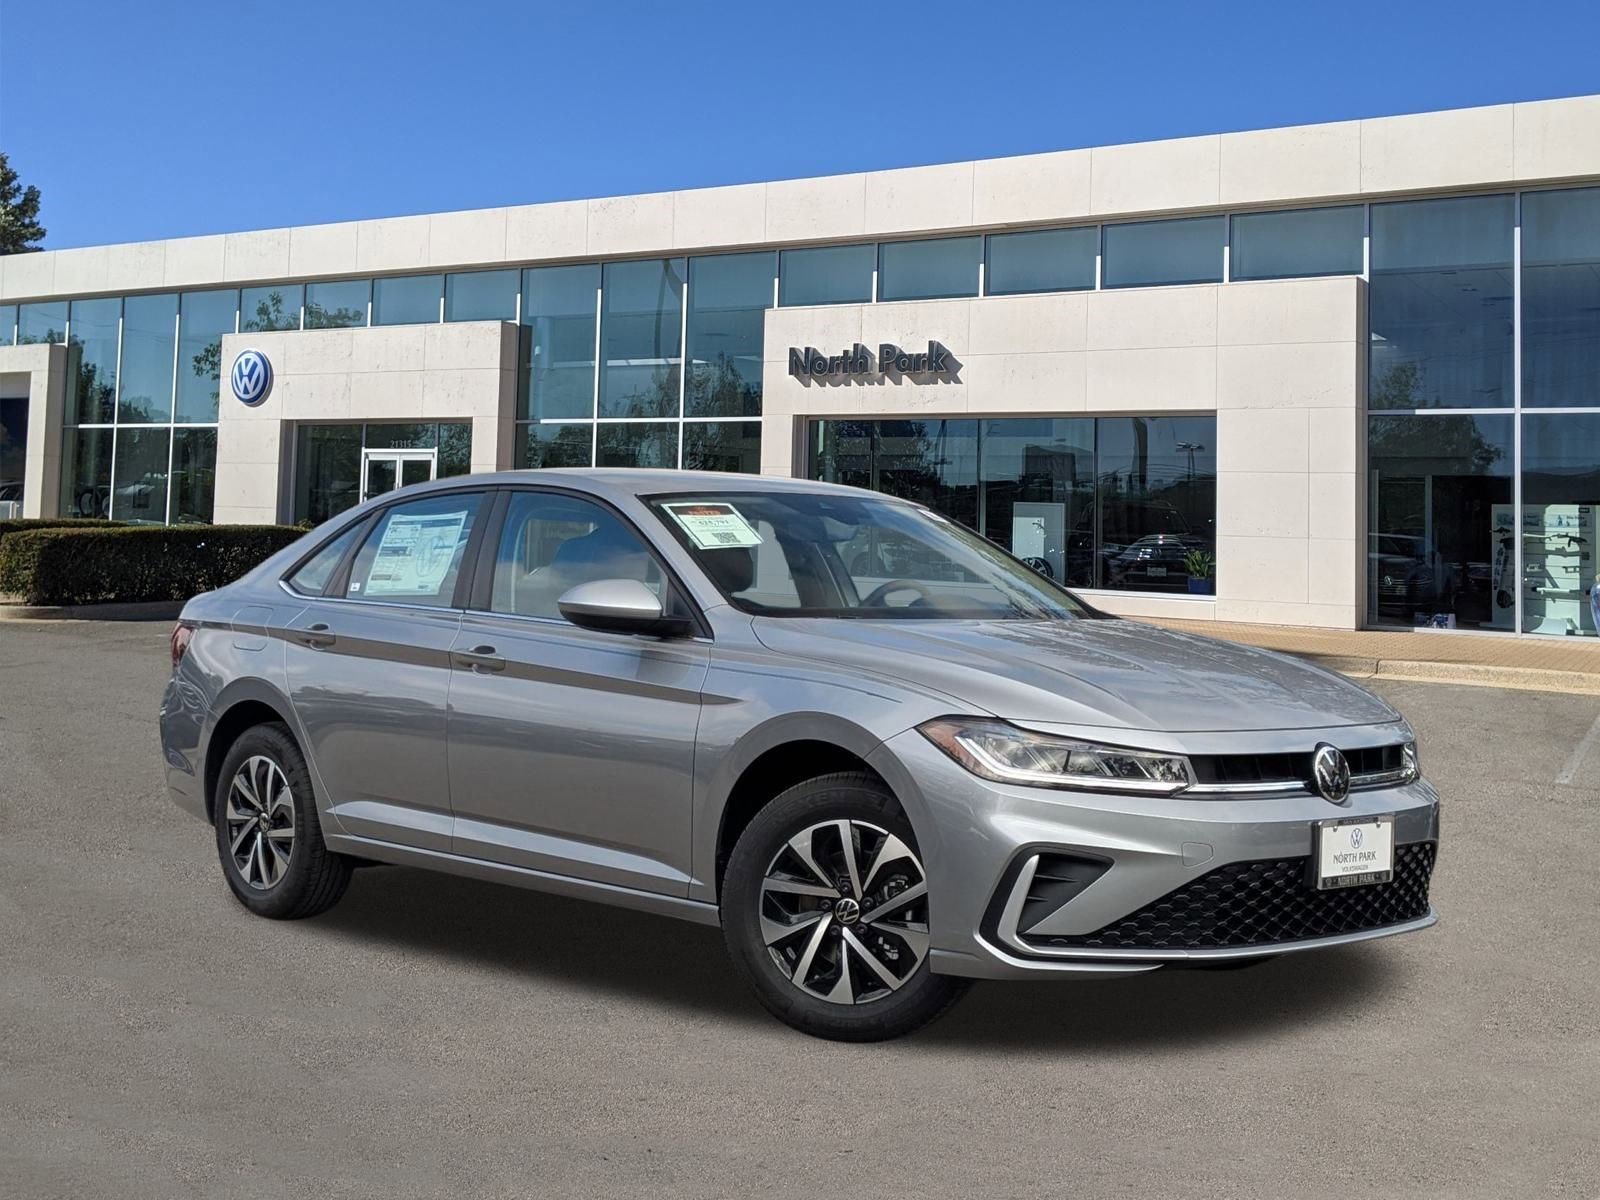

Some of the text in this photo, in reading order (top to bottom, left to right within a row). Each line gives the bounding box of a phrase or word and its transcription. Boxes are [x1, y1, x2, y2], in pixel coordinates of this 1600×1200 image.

[789, 340, 949, 376] North Park
[1333, 851, 1377, 864] NORTH PARK
